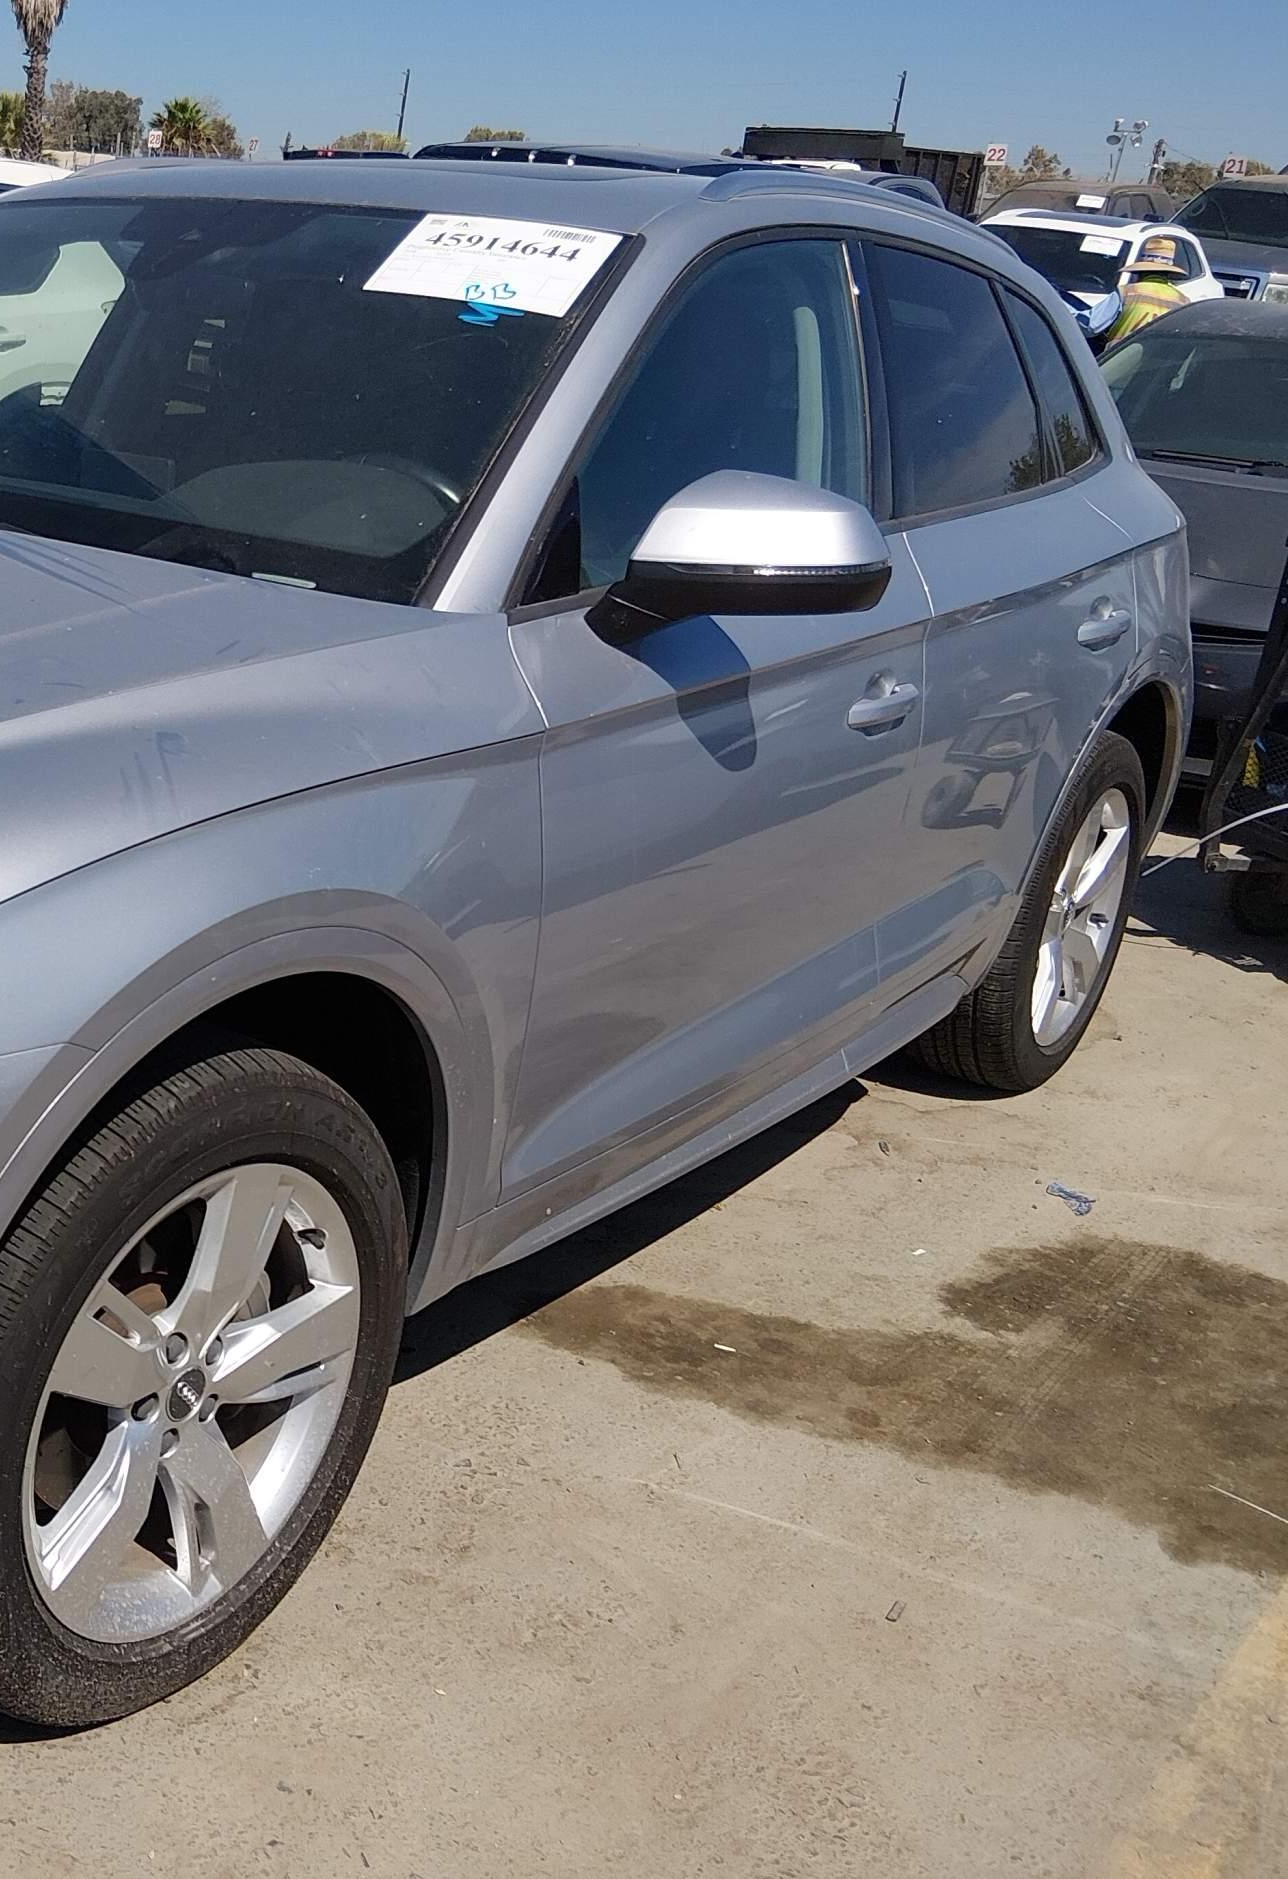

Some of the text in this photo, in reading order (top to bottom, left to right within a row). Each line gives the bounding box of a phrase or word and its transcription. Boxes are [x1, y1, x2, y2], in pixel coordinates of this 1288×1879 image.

[150, 134, 161, 145] 28
[987, 148, 1006, 162] 22
[1225, 158, 1244, 174] 21
[425, 231, 582, 262] 45914644
